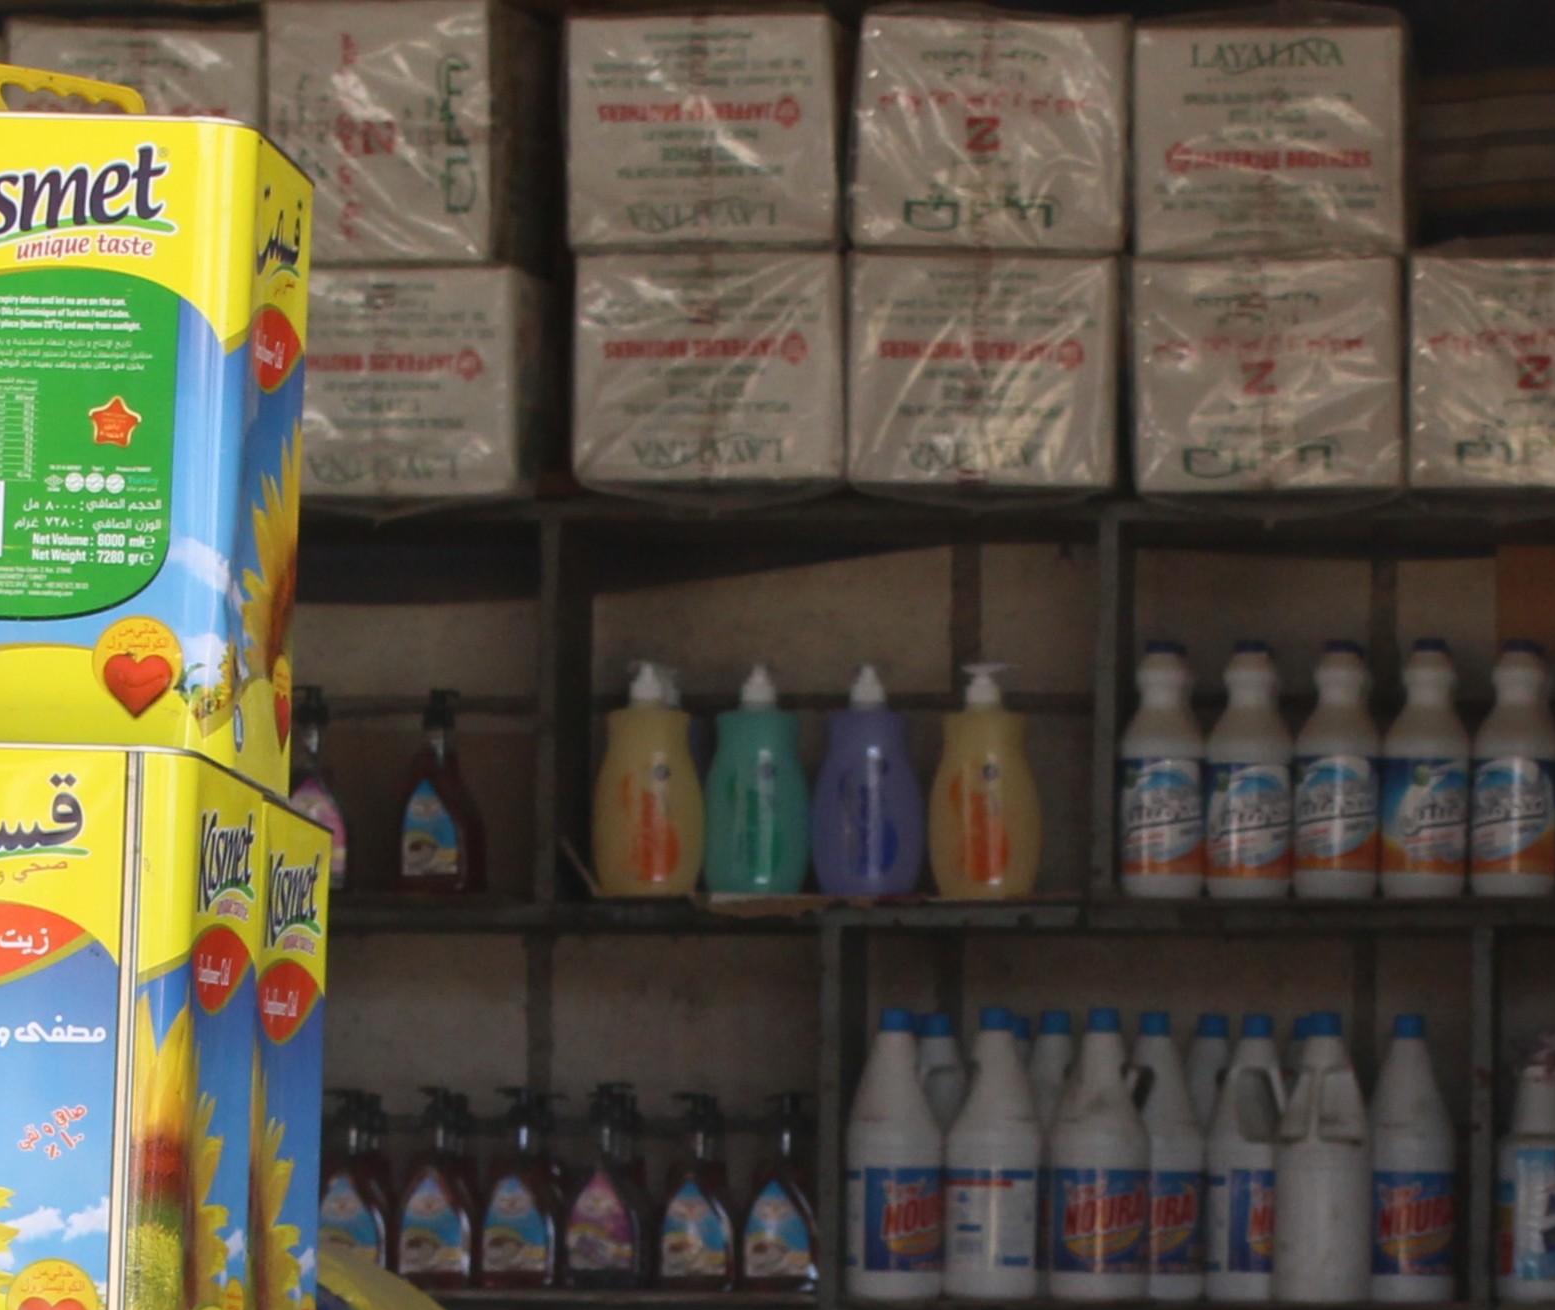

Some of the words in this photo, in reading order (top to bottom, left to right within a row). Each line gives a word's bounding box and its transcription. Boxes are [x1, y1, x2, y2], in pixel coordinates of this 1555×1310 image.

[1190, 37, 1343, 74] LAYALINA
[16, 237, 90, 261] unique
[96, 234, 154, 257] taste
[23, 498, 40, 511] مل
[127, 498, 162, 512] الحجم
[14, 517, 39, 530] غرام
[92, 518, 132, 530] الصافي
[135, 519, 162, 530] الوزن
[32, 534, 47, 546] Net
[97, 535, 125, 548] 8000
[31, 550, 47, 562] Net
[49, 550, 86, 565] Weight
[97, 550, 125, 565] 7280
[197, 810, 255, 914] Kismet
[11, 857, 68, 883] صحي
[263, 852, 321, 949] Kismet
[16, 1011, 107, 1045] مصفى
